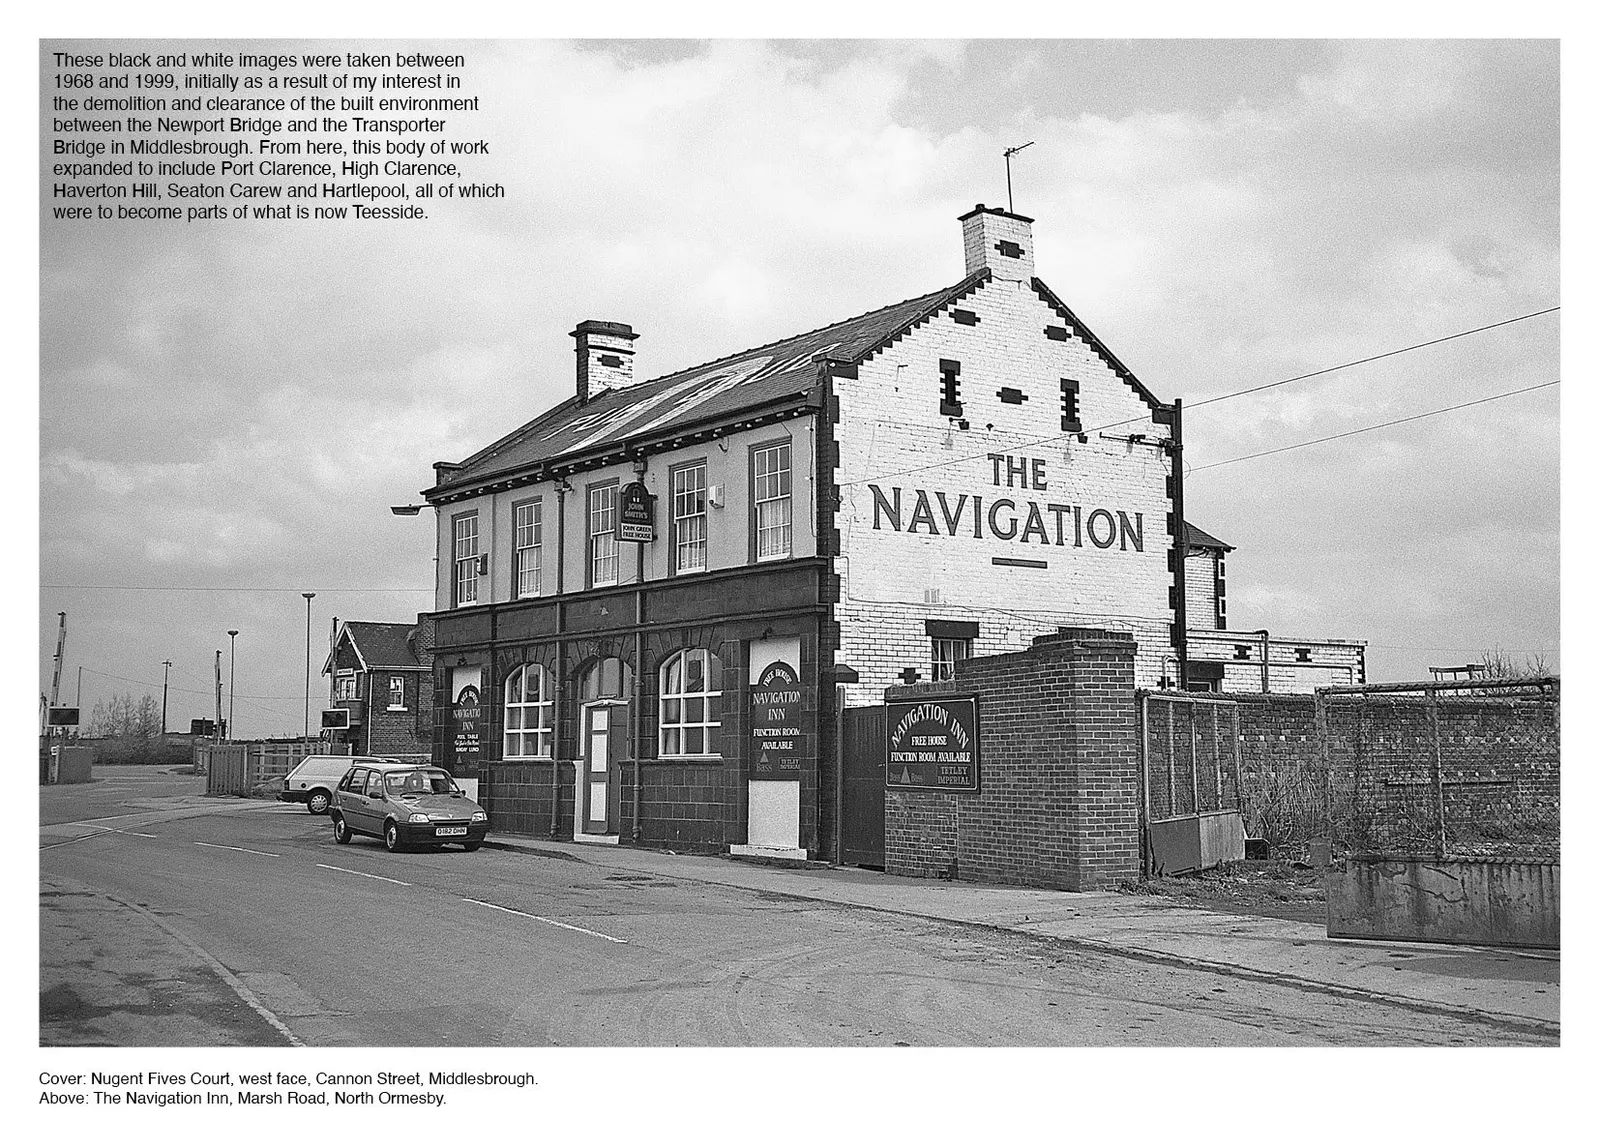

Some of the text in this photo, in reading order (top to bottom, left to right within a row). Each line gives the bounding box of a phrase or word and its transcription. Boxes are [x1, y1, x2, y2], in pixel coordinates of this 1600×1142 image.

[987, 453, 1048, 491] THE
[868, 484, 1144, 552] NAVIGATION
[635, 532, 652, 540] HOUSE
[763, 669, 793, 687] FREE HOUSE
[453, 708, 481, 719] NAVIGATIO
[768, 708, 786, 721] INN
[462, 721, 474, 731] INN
[892, 704, 969, 750] NAVIGATION INN
[753, 728, 781, 737] FUNCTION
[761, 741, 793, 750] AVAILABLE
[911, 736, 948, 746] FREE HOUSE
[891, 752, 971, 763] FUNCTION ROOM AVAILABLE
[941, 767, 968, 775] TETLEY
[938, 776, 970, 785] IMPERIAL
